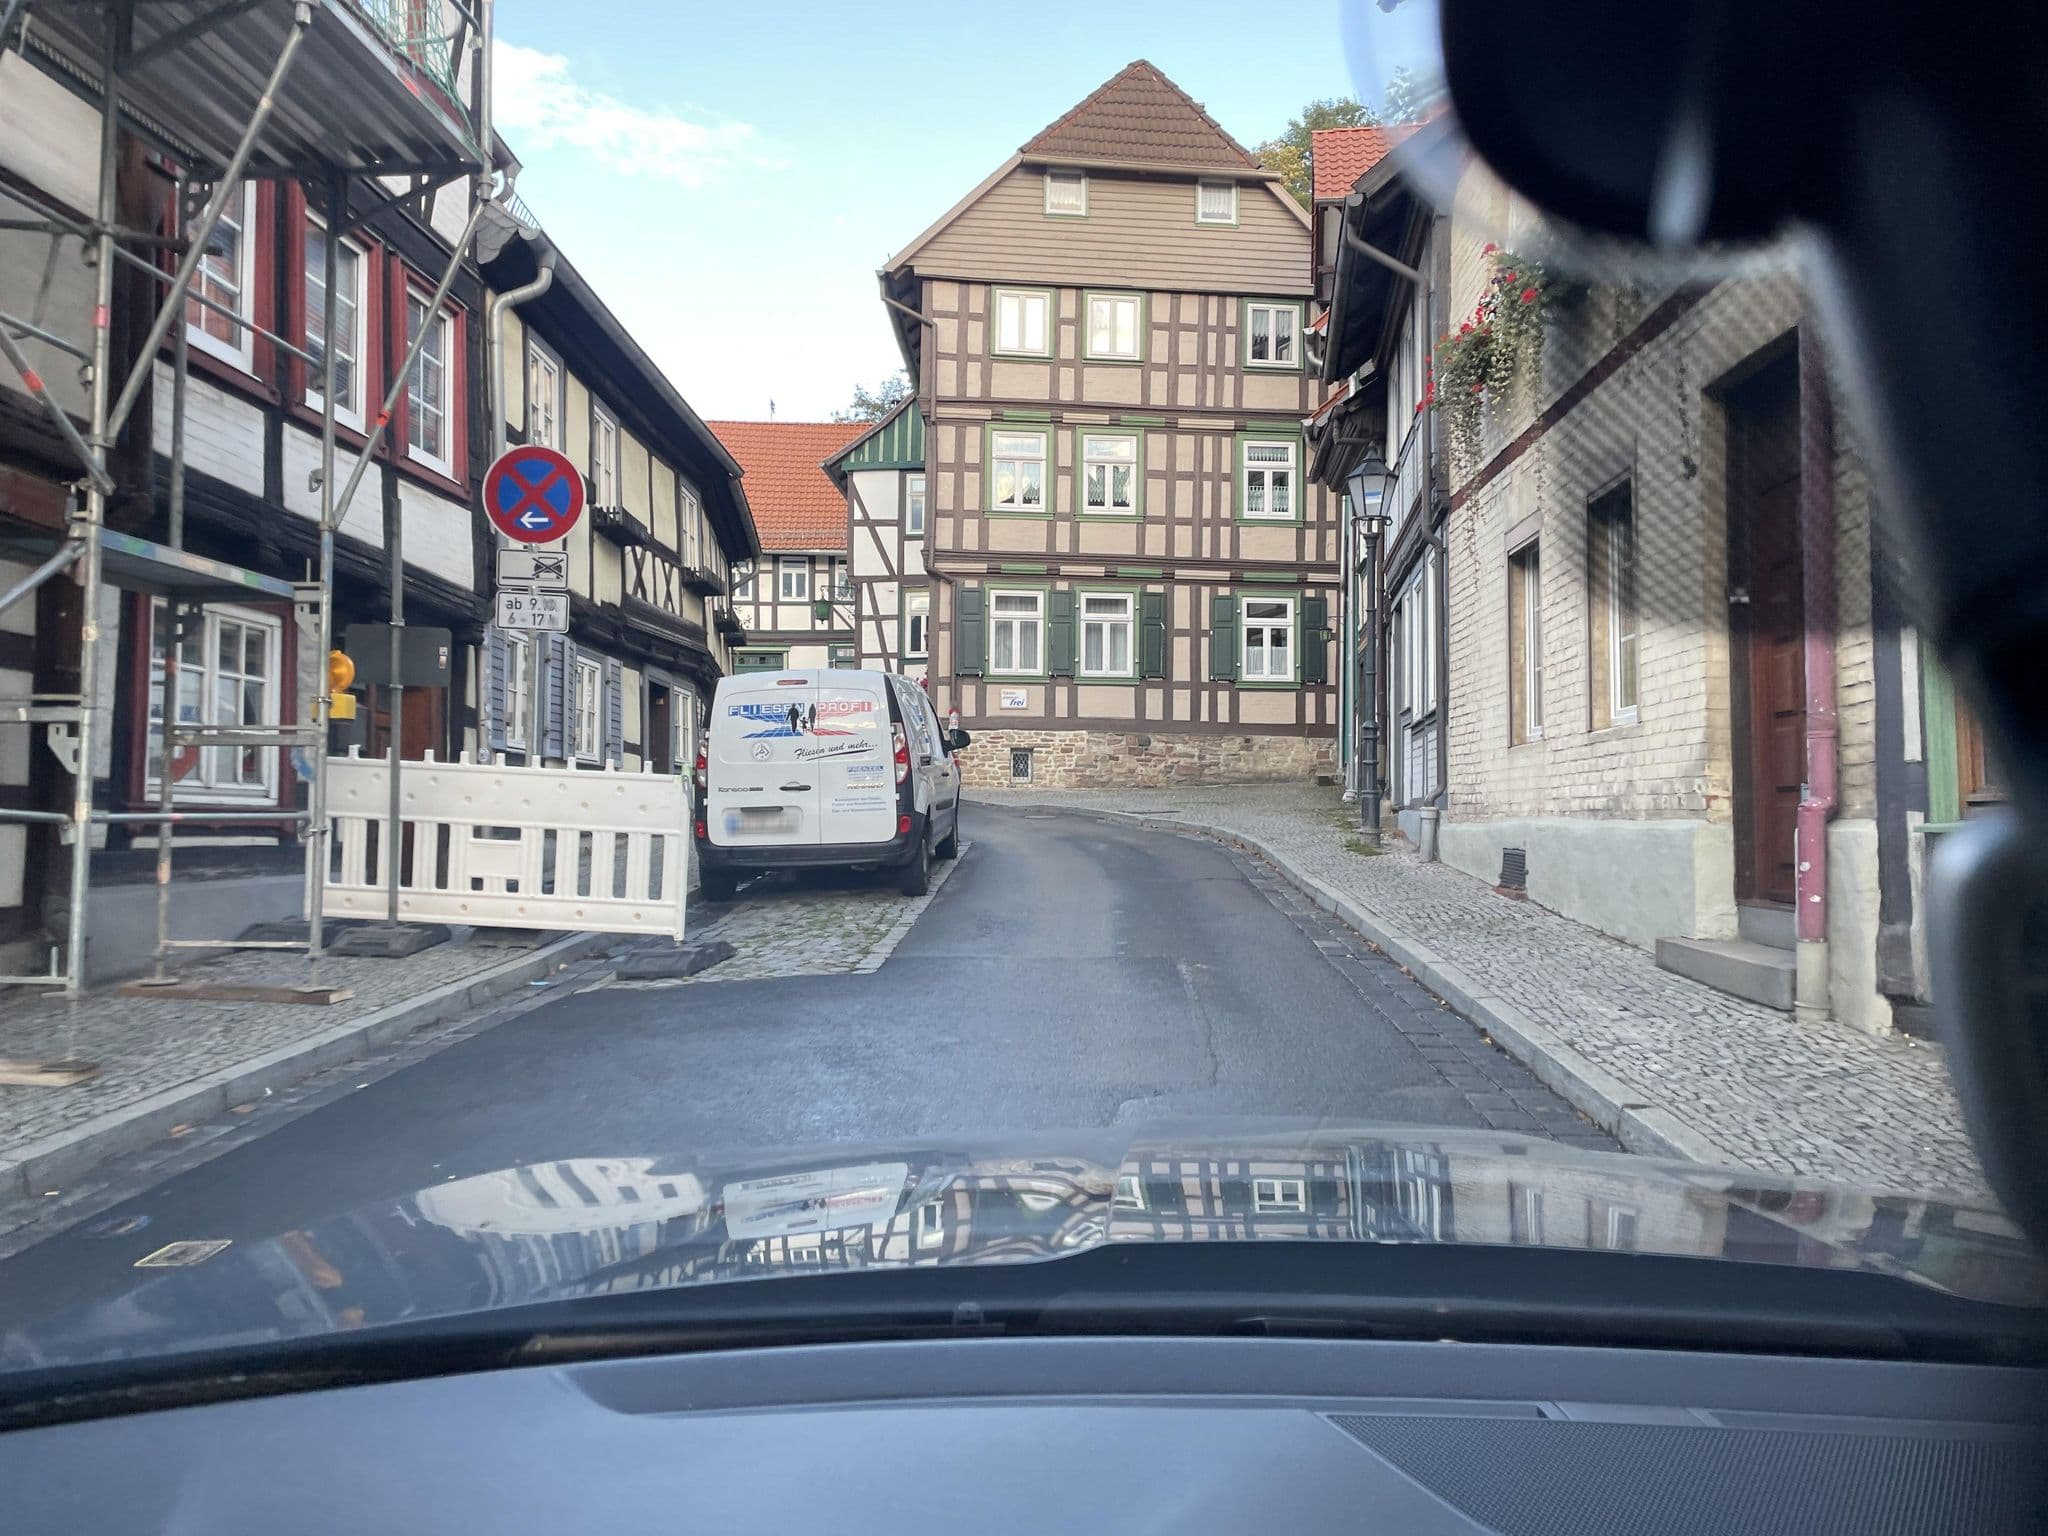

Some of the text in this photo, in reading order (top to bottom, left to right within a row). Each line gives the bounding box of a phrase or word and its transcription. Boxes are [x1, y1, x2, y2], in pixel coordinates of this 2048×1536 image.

[505, 597, 522, 610] ab
[508, 612, 516, 625] 6
[531, 612, 545, 626] 17
[728, 702, 871, 716] FLIESEN PROFI
[794, 748, 825, 760] Fliesen
[828, 742, 845, 753] und
